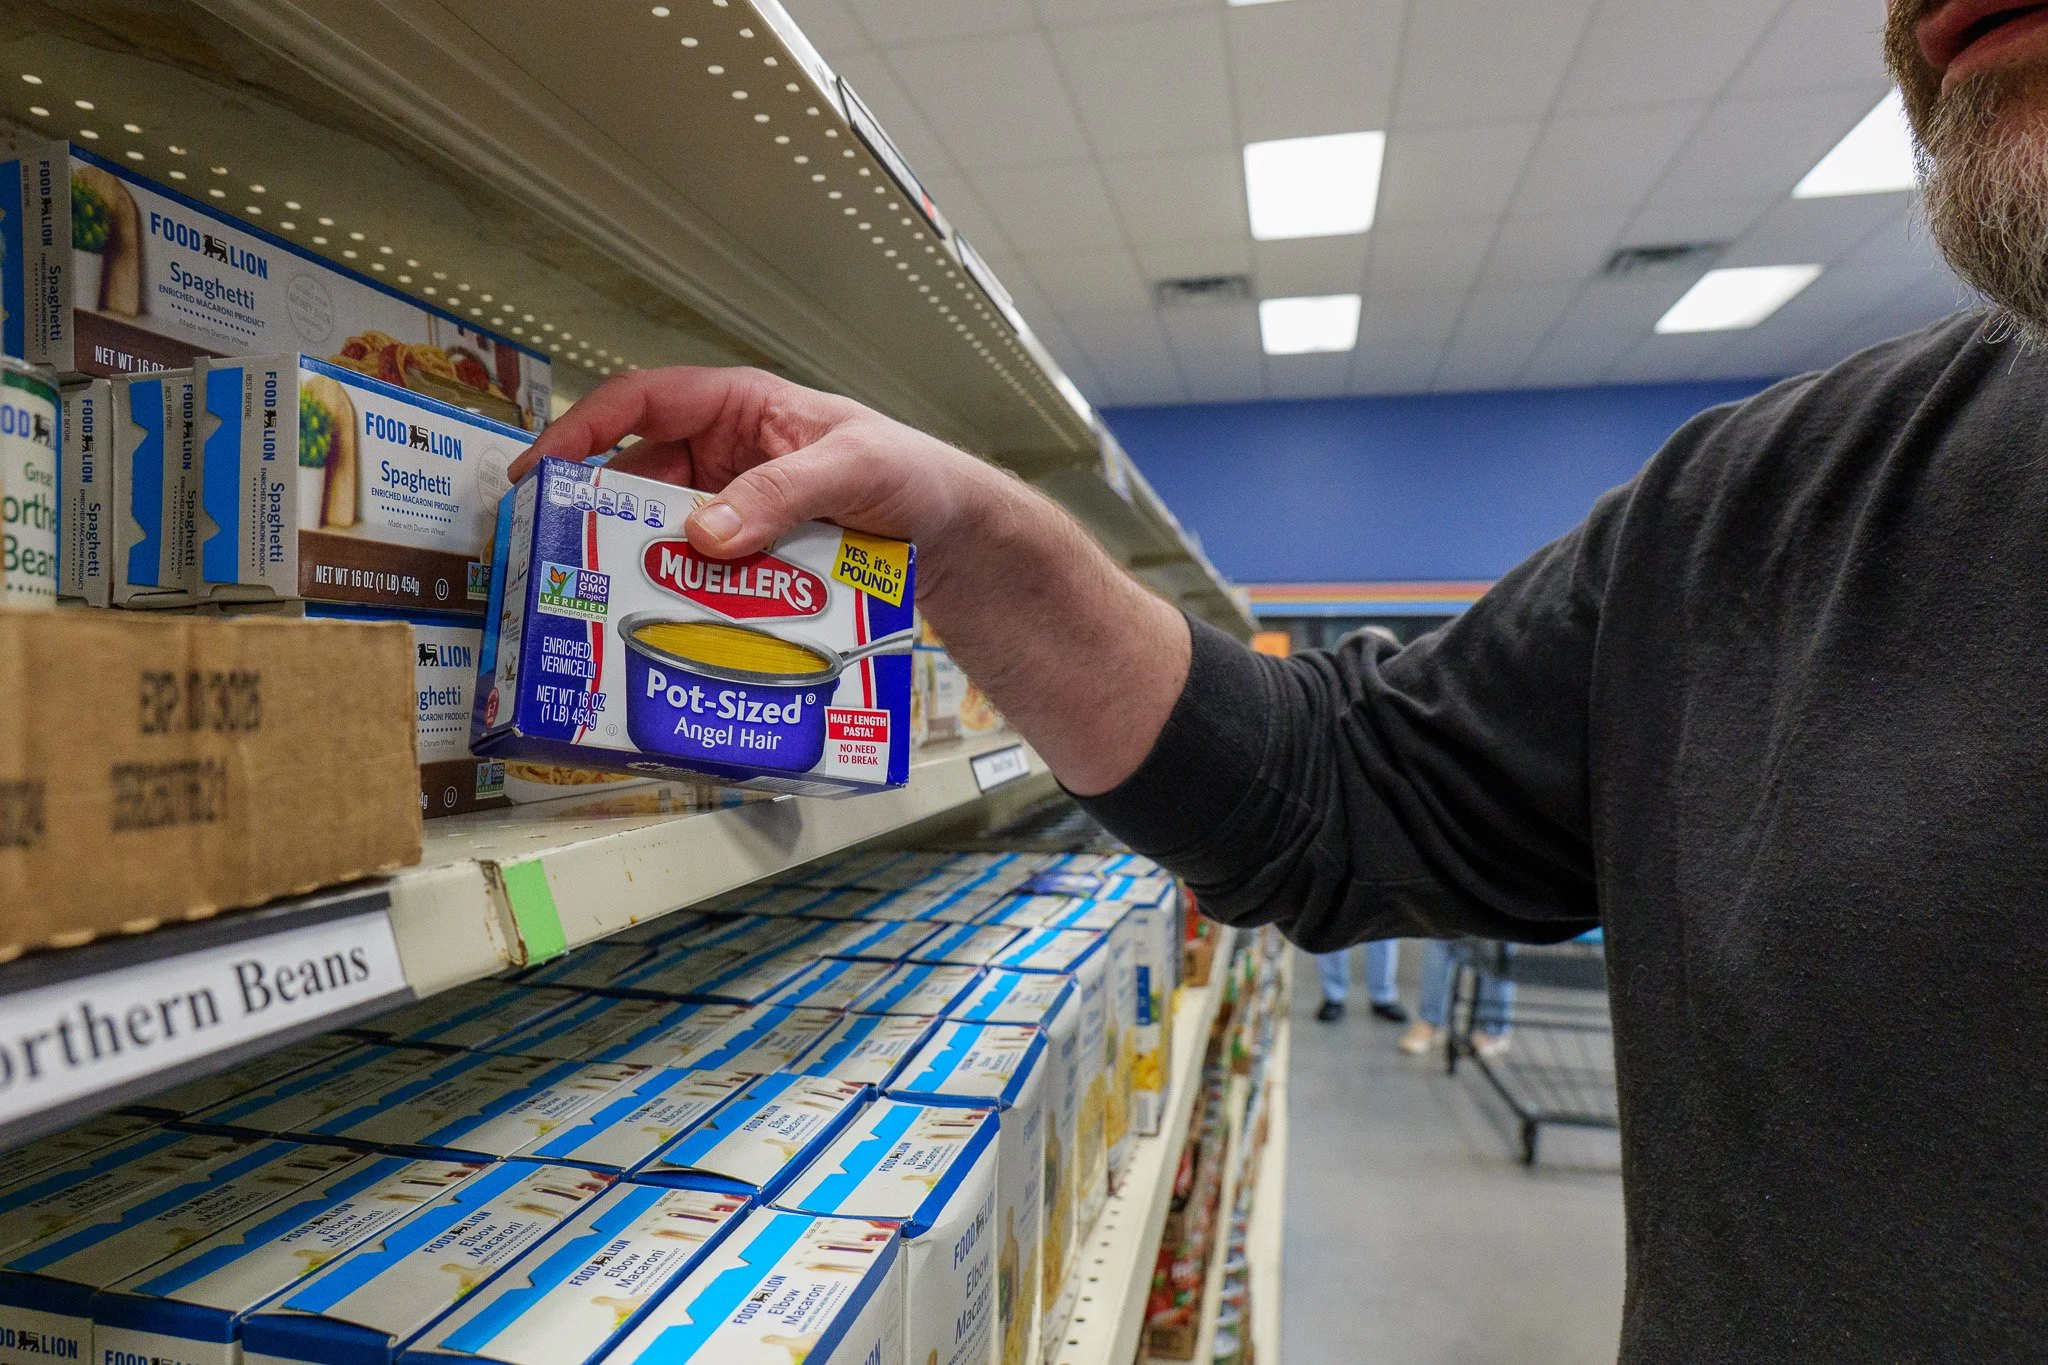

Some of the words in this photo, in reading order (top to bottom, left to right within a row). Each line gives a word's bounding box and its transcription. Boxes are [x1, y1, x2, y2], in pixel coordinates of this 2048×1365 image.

[40, 160, 50, 196] FOOD
[42, 214, 53, 246] LION
[150, 212, 200, 252] FOOD
[230, 245, 268, 280] LION
[170, 261, 255, 311] Spaghetti
[50, 266, 62, 341] Spaghetti
[158, 284, 194, 304] ENRICHED
[196, 298, 234, 318] MACARONI
[234, 310, 266, 328] PRODUCT
[95, 345, 116, 368] NET
[118, 350, 133, 372] WT
[182, 384, 194, 418] FOOD
[264, 372, 276, 407] FOOD
[82, 400, 94, 435] FOOD
[263, 430, 276, 462] LION
[366, 412, 407, 446] FOOD
[430, 431, 462, 462] LION
[82, 454, 94, 484] LION
[182, 439, 192, 470] LION
[381, 460, 451, 497] Spaghetti
[553, 480, 571, 493] 200
[372, 487, 402, 502] ENRICHED
[402, 494, 434, 509] MACARONI
[434, 500, 460, 514] PRODUCT
[184, 490, 197, 566] Spaghetti
[267, 482, 284, 562] Spaghetti
[388, 520, 402, 530] Made
[403, 522, 414, 530] with
[88, 502, 101, 578] Spaghetti
[258, 543, 266, 578] PRODUCT
[844, 544, 870, 568] YES,
[874, 556, 892, 576] it's
[894, 568, 902, 579] a
[316, 564, 334, 585] NET
[335, 568, 348, 586] WT
[351, 568, 362, 588] 16
[364, 570, 374, 590] OZ
[376, 572, 384, 594] (1
[386, 573, 400, 595] LB)
[401, 576, 420, 597] 454g
[578, 582, 607, 596] GMO
[580, 572, 608, 586] NON
[660, 547, 812, 612] MUELLER'S
[840, 561, 900, 598] POUND!
[544, 594, 606, 614] VERIFIED
[578, 590, 606, 603] Project
[538, 604, 608, 623] nongmoproject.org
[440, 645, 472, 668] LION
[543, 636, 590, 660] ENRICHED
[541, 654, 596, 679] VERMICELLI
[536, 684, 558, 702] NET
[558, 688, 576, 706] WT
[577, 690, 589, 708] 16
[592, 694, 606, 711] OZ
[418, 712, 444, 722] ACARONI
[444, 712, 470, 721] PRODUCT
[542, 704, 550, 723] (1
[552, 706, 570, 726] LB)
[572, 708, 598, 730] 454g
[830, 714, 852, 724] HALF
[854, 714, 886, 727] LENGTH
[844, 726, 874, 738] PASTA!
[674, 716, 733, 748] Angel
[740, 728, 782, 750] Hair
[838, 754, 848, 764] TO
[850, 754, 878, 766] BREAK
[840, 744, 852, 754] NO
[854, 744, 876, 754] NEED
[233, 945, 370, 1016] Beans
[743, 1116, 762, 1132] FOOD
[766, 1104, 782, 1116] LION
[768, 1113, 792, 1130] Elbow
[778, 1112, 810, 1136] Macaroni
[878, 1156, 897, 1172] FOOD
[900, 1142, 912, 1154] LION
[903, 1149, 924, 1166] Elbow
[914, 1146, 943, 1171] Macaroni
[280, 1222, 315, 1244] FOOD
[326, 1203, 355, 1219] LION
[316, 1212, 358, 1236] Elbow
[322, 1209, 384, 1244] Macaroni
[424, 1234, 454, 1254] FOOD
[463, 1211, 492, 1229] LION
[458, 1224, 498, 1248] Elbow
[466, 1222, 524, 1258] Macaroni
[954, 1222, 975, 1270] FOOD
[569, 1265, 601, 1287] FOOD
[604, 1238, 632, 1260] LION
[604, 1252, 640, 1278] Elbow
[615, 1249, 666, 1289] Macaroni
[732, 1298, 761, 1325] FOOD
[762, 1274, 788, 1294] LION
[768, 1288, 802, 1316] Elbow
[782, 1283, 827, 1326] Macaroni
[42, 1335, 78, 1359] LION
